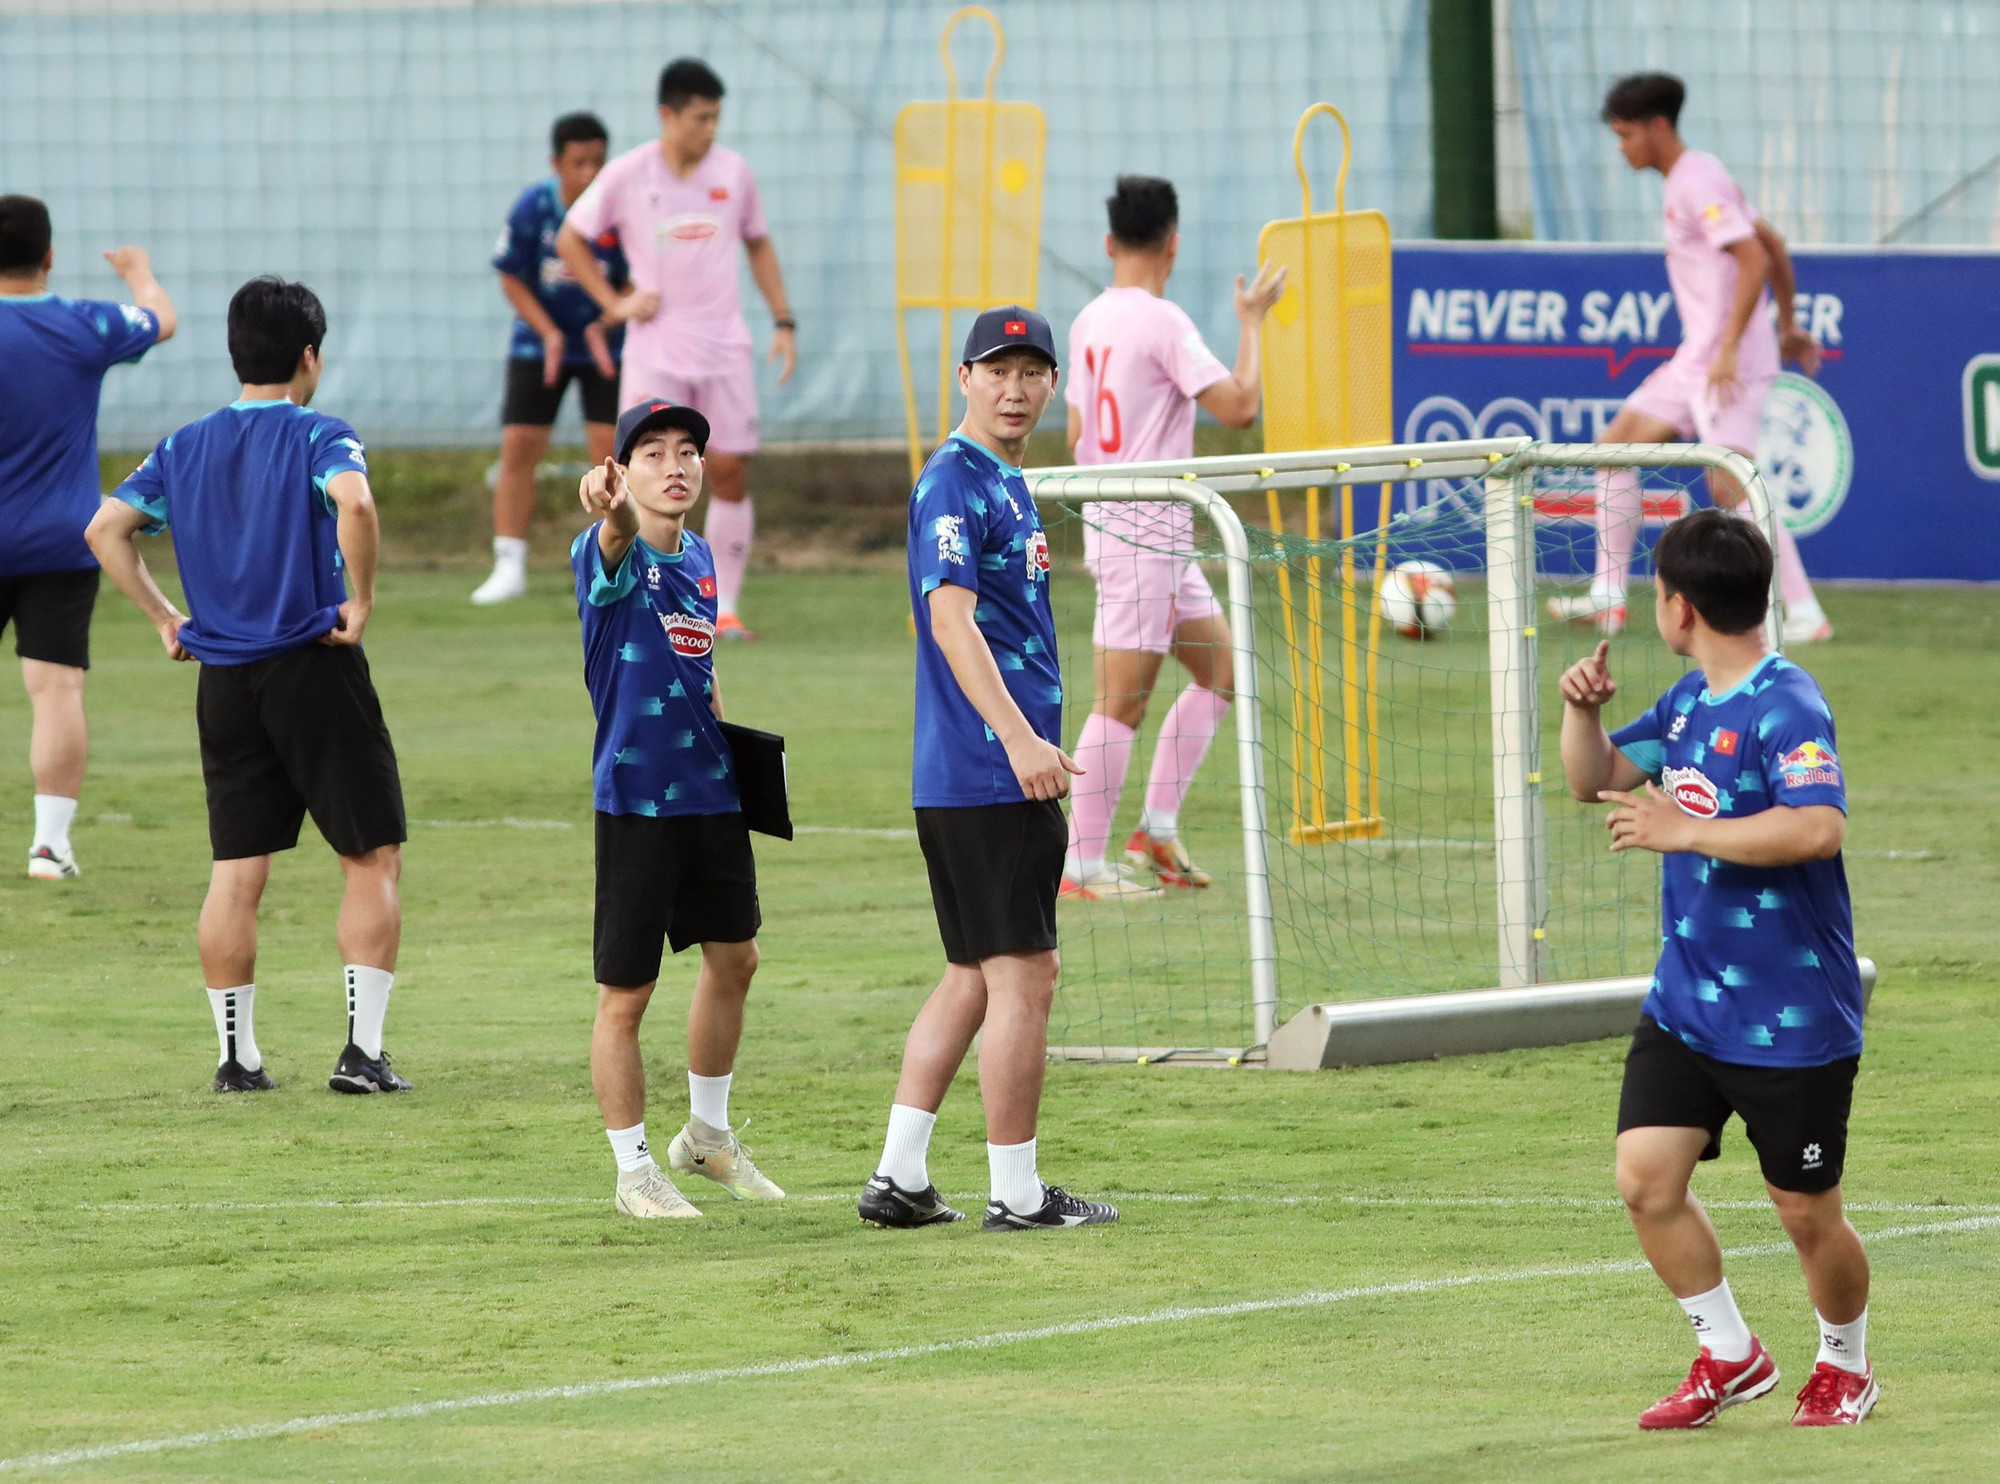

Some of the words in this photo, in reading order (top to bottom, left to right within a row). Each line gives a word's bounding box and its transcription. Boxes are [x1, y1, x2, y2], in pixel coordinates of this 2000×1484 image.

[1406, 288, 1567, 342] NEVER
[1578, 290, 1673, 343] SAY
[1785, 769, 1813, 787] Red
